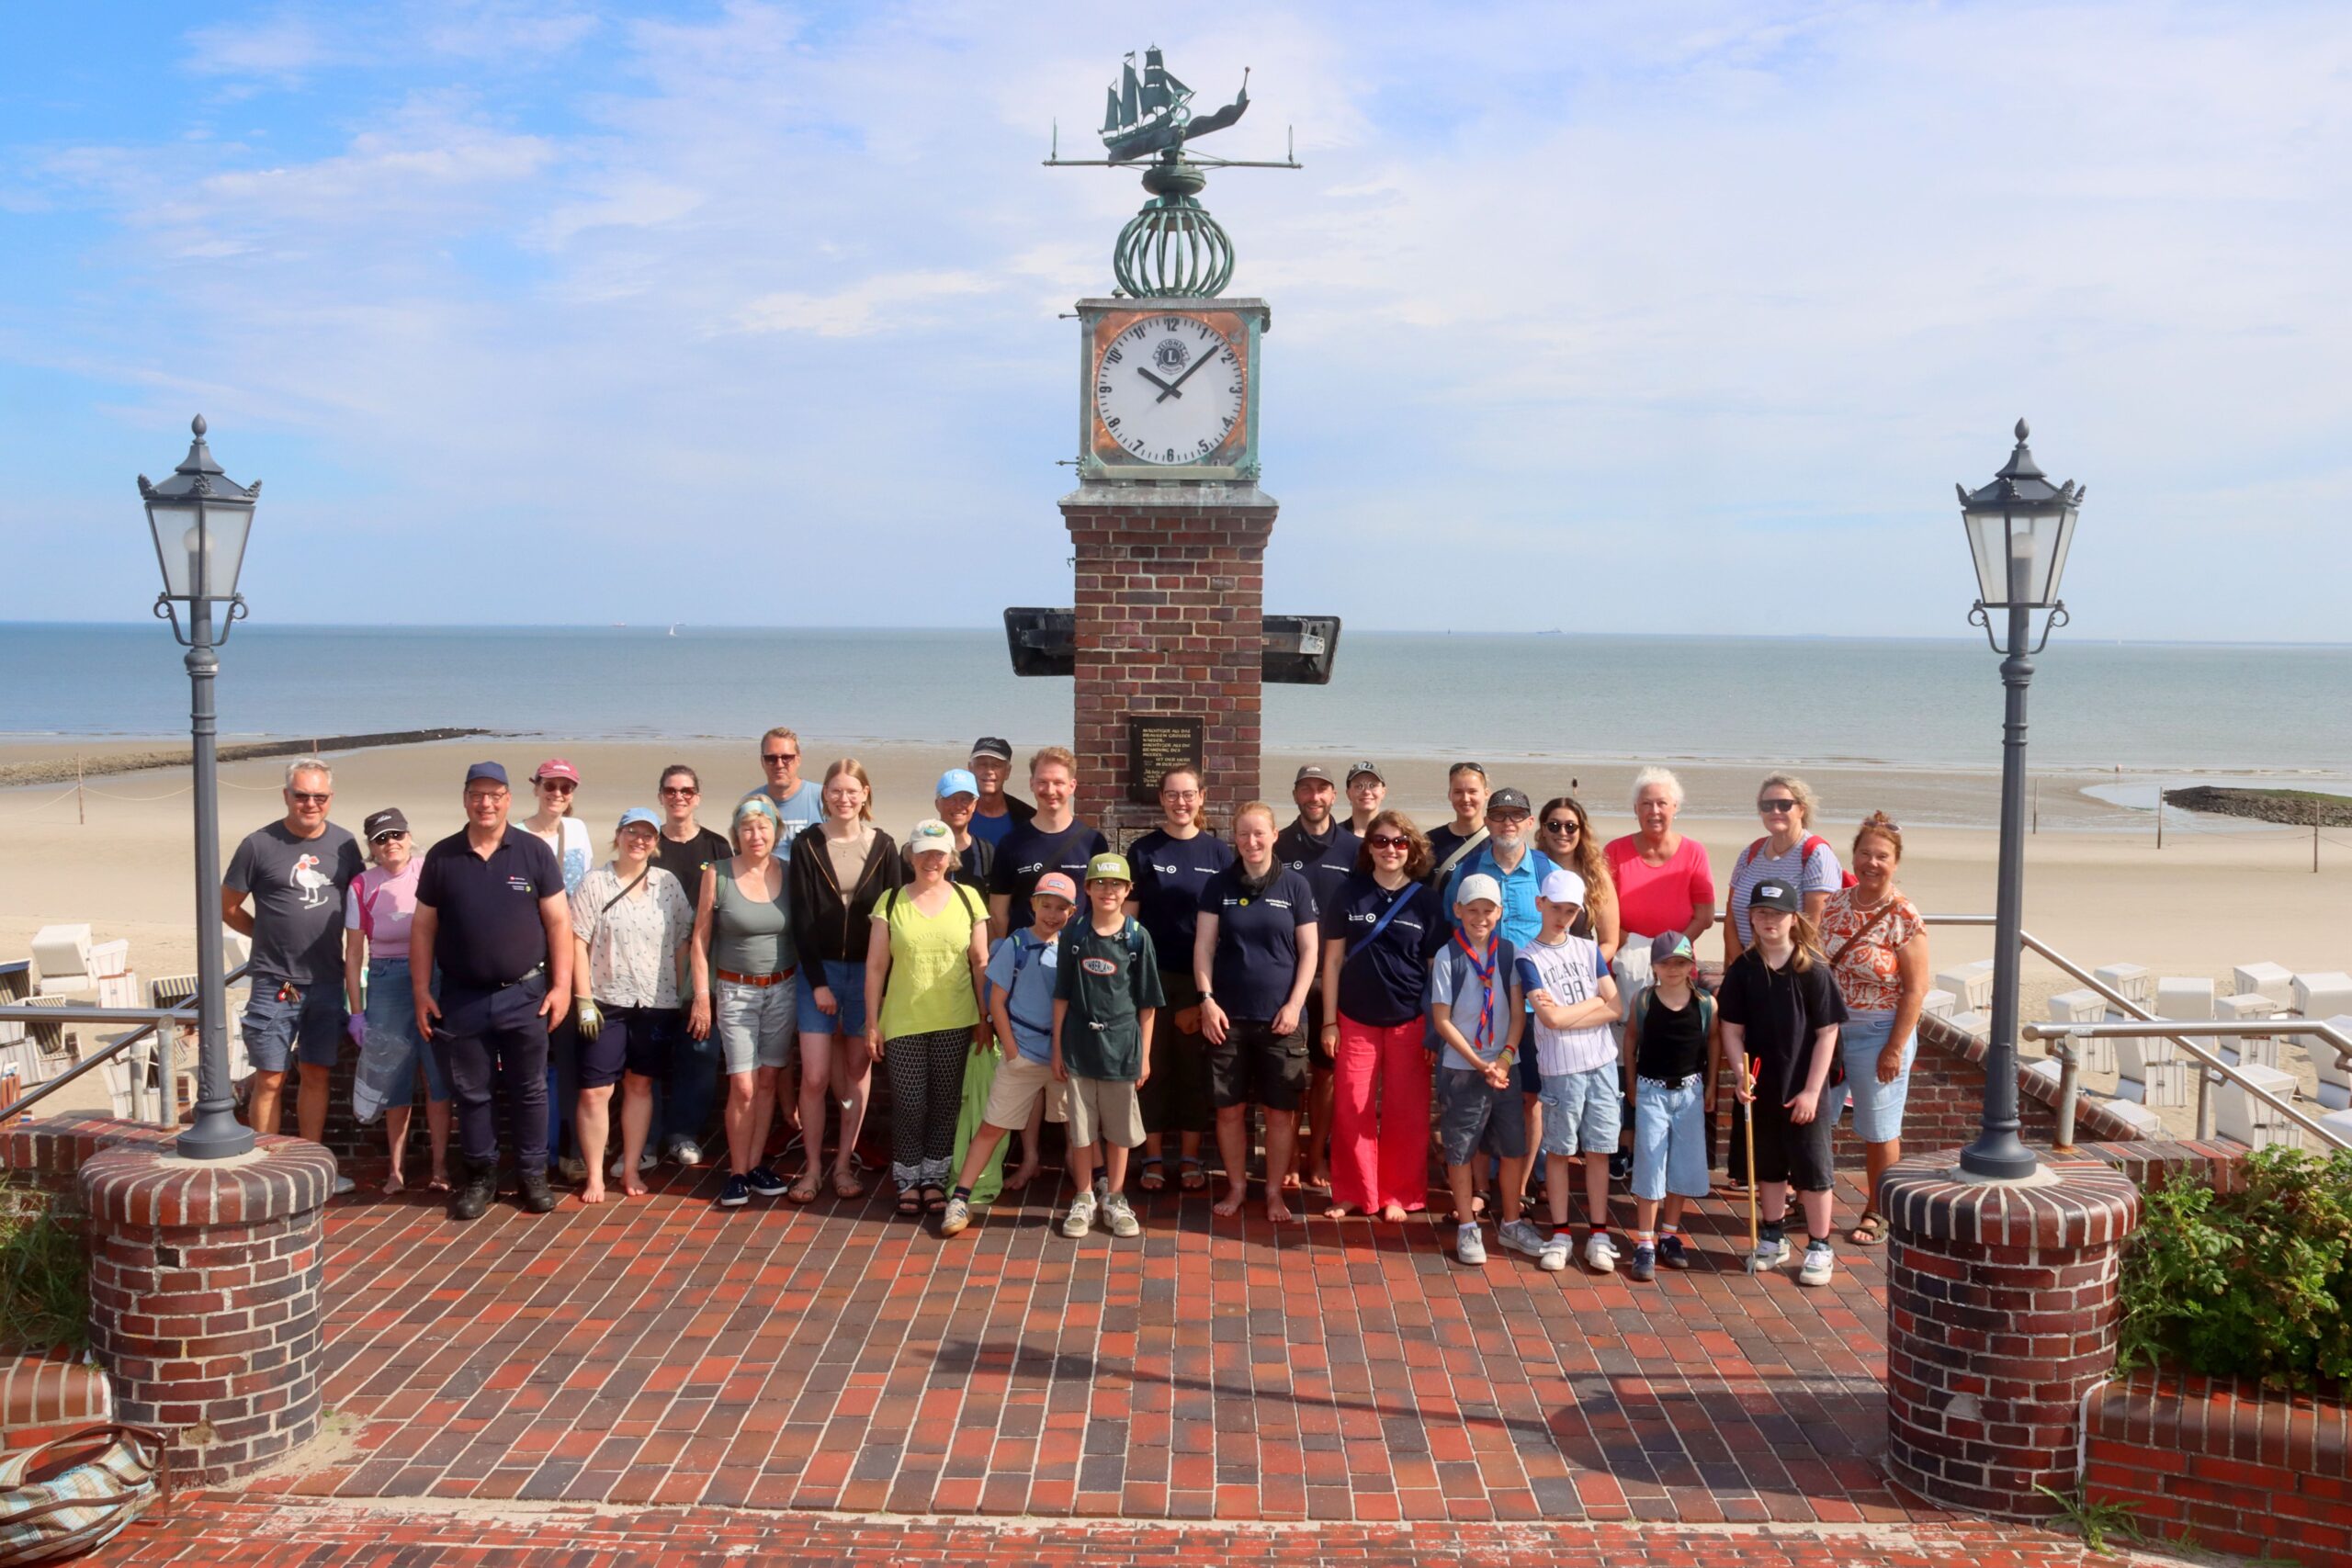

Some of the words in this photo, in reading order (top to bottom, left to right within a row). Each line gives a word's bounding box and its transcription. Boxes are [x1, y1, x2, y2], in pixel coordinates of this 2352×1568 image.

[1166, 318, 1180, 332] 12
[1134, 325, 1145, 340] 11
[1200, 328, 1207, 339] 1
[1161, 340, 1182, 348] LIONS
[1109, 351, 1123, 364] 10
[1168, 350, 1177, 363] L
[1221, 354, 1234, 363] 2
[1108, 418, 1120, 428] 8
[1222, 417, 1233, 426] 4
[1133, 439, 1145, 452] 7
[1199, 439, 1209, 453] 5
[1167, 448, 1174, 462] 6
[1096, 863, 1121, 873] VANS
[1544, 962, 1593, 987] ATLANTA
[1562, 980, 1587, 1006] 98
